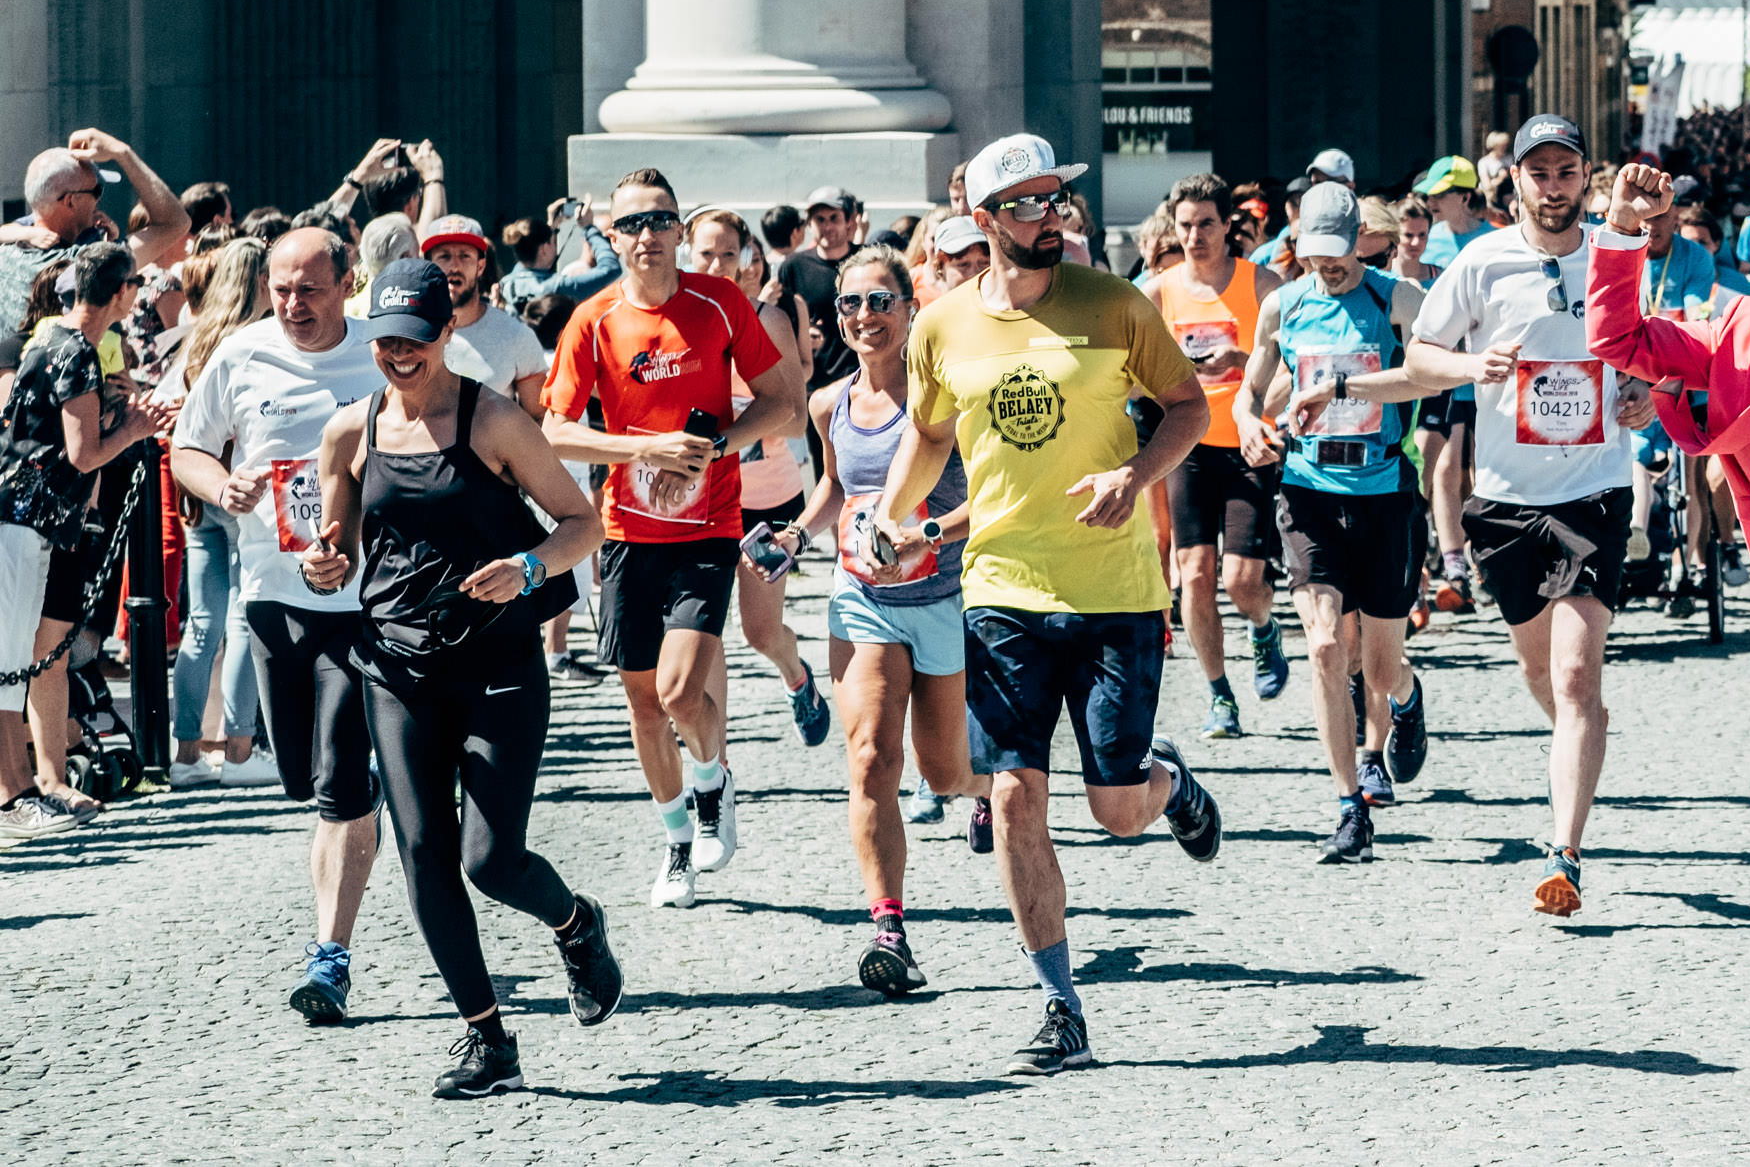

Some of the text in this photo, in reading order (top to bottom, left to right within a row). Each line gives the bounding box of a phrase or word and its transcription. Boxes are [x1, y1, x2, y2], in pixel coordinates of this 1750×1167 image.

[1101, 106, 1192, 124] LOU & FRIENDS
[641, 363, 681, 383] WORLD
[997, 397, 1053, 420] BELAEY
[1530, 399, 1592, 417] 104212
[290, 503, 322, 520] 109
